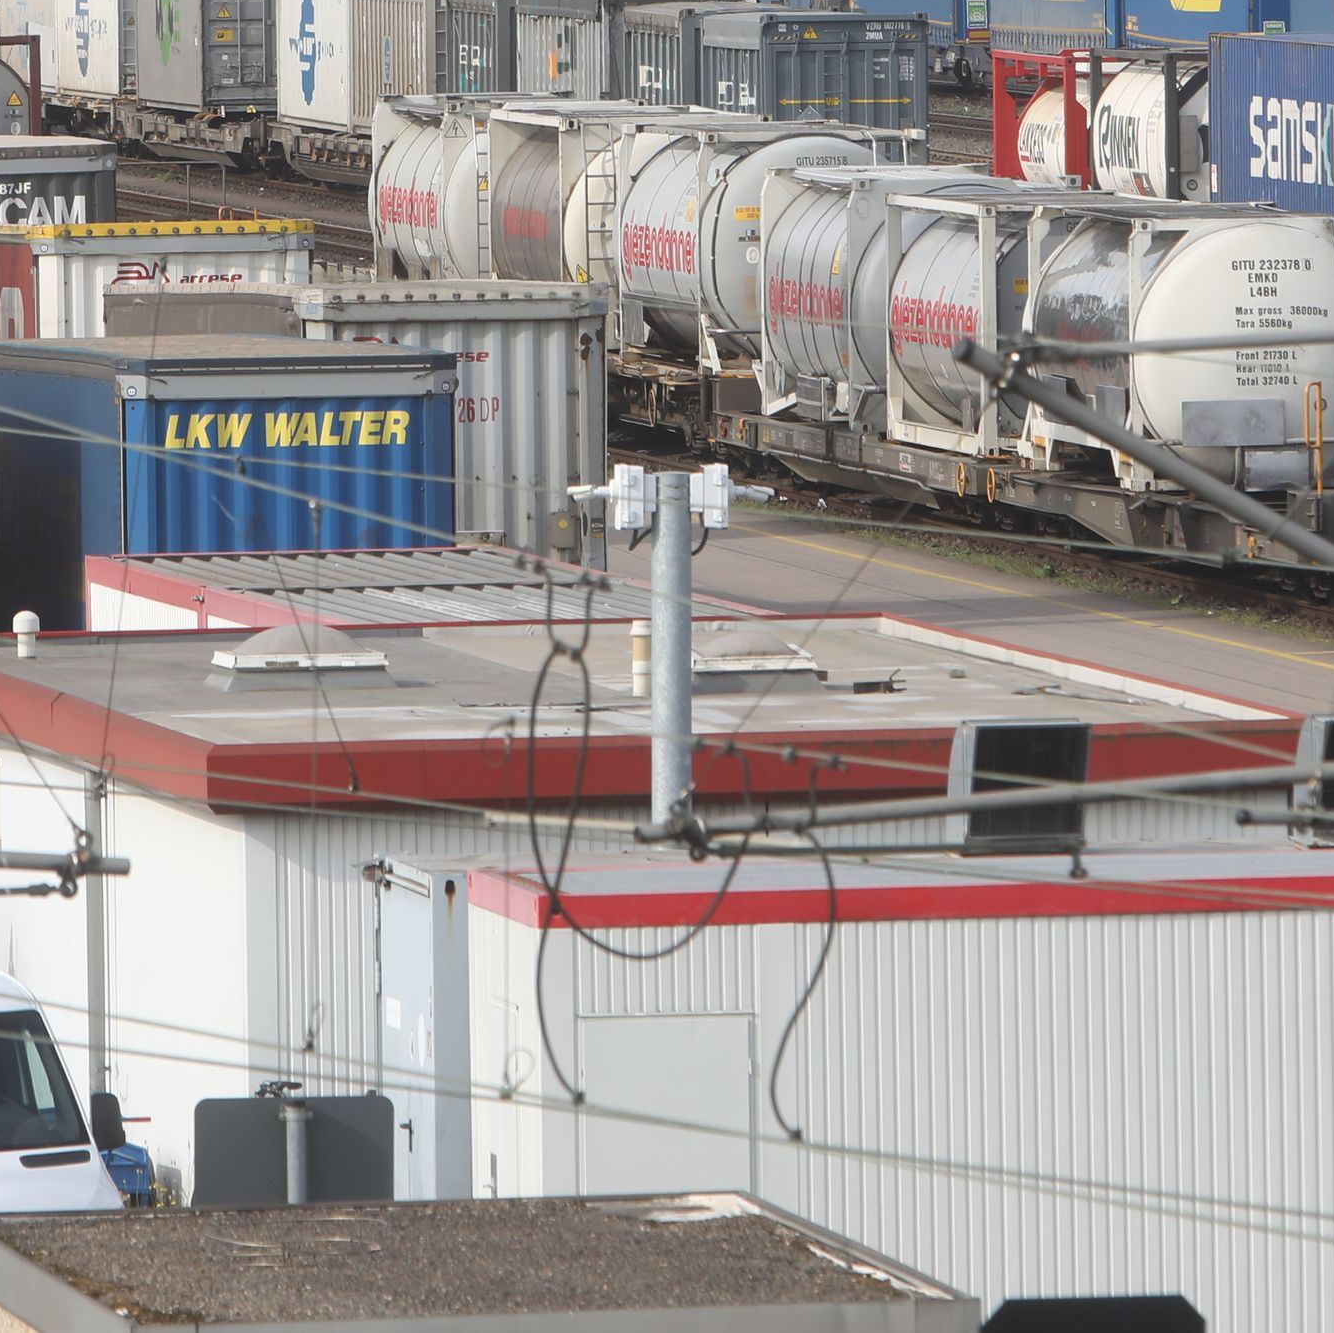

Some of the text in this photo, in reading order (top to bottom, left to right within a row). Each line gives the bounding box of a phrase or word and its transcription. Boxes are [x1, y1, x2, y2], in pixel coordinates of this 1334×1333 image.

[796, 156, 814, 166] GITU
[816, 156, 842, 166] 235715
[622, 209, 697, 282] giezendanner
[1231, 259, 1255, 271] GITU
[1259, 259, 1300, 271] 232378
[1247, 272, 1278, 283] EMKD
[1250, 286, 1278, 297] L4BH
[1235, 306, 1254, 315] Max
[1258, 307, 1282, 316] gross
[1235, 318, 1255, 328] Tara
[1235, 350, 1259, 361] Front
[1263, 350, 1289, 360] 21730
[1235, 364, 1256, 373] Rear
[1236, 377, 1259, 386] Total
[1262, 376, 1289, 386] 32740
[164, 409, 411, 449] LKW WALTER
